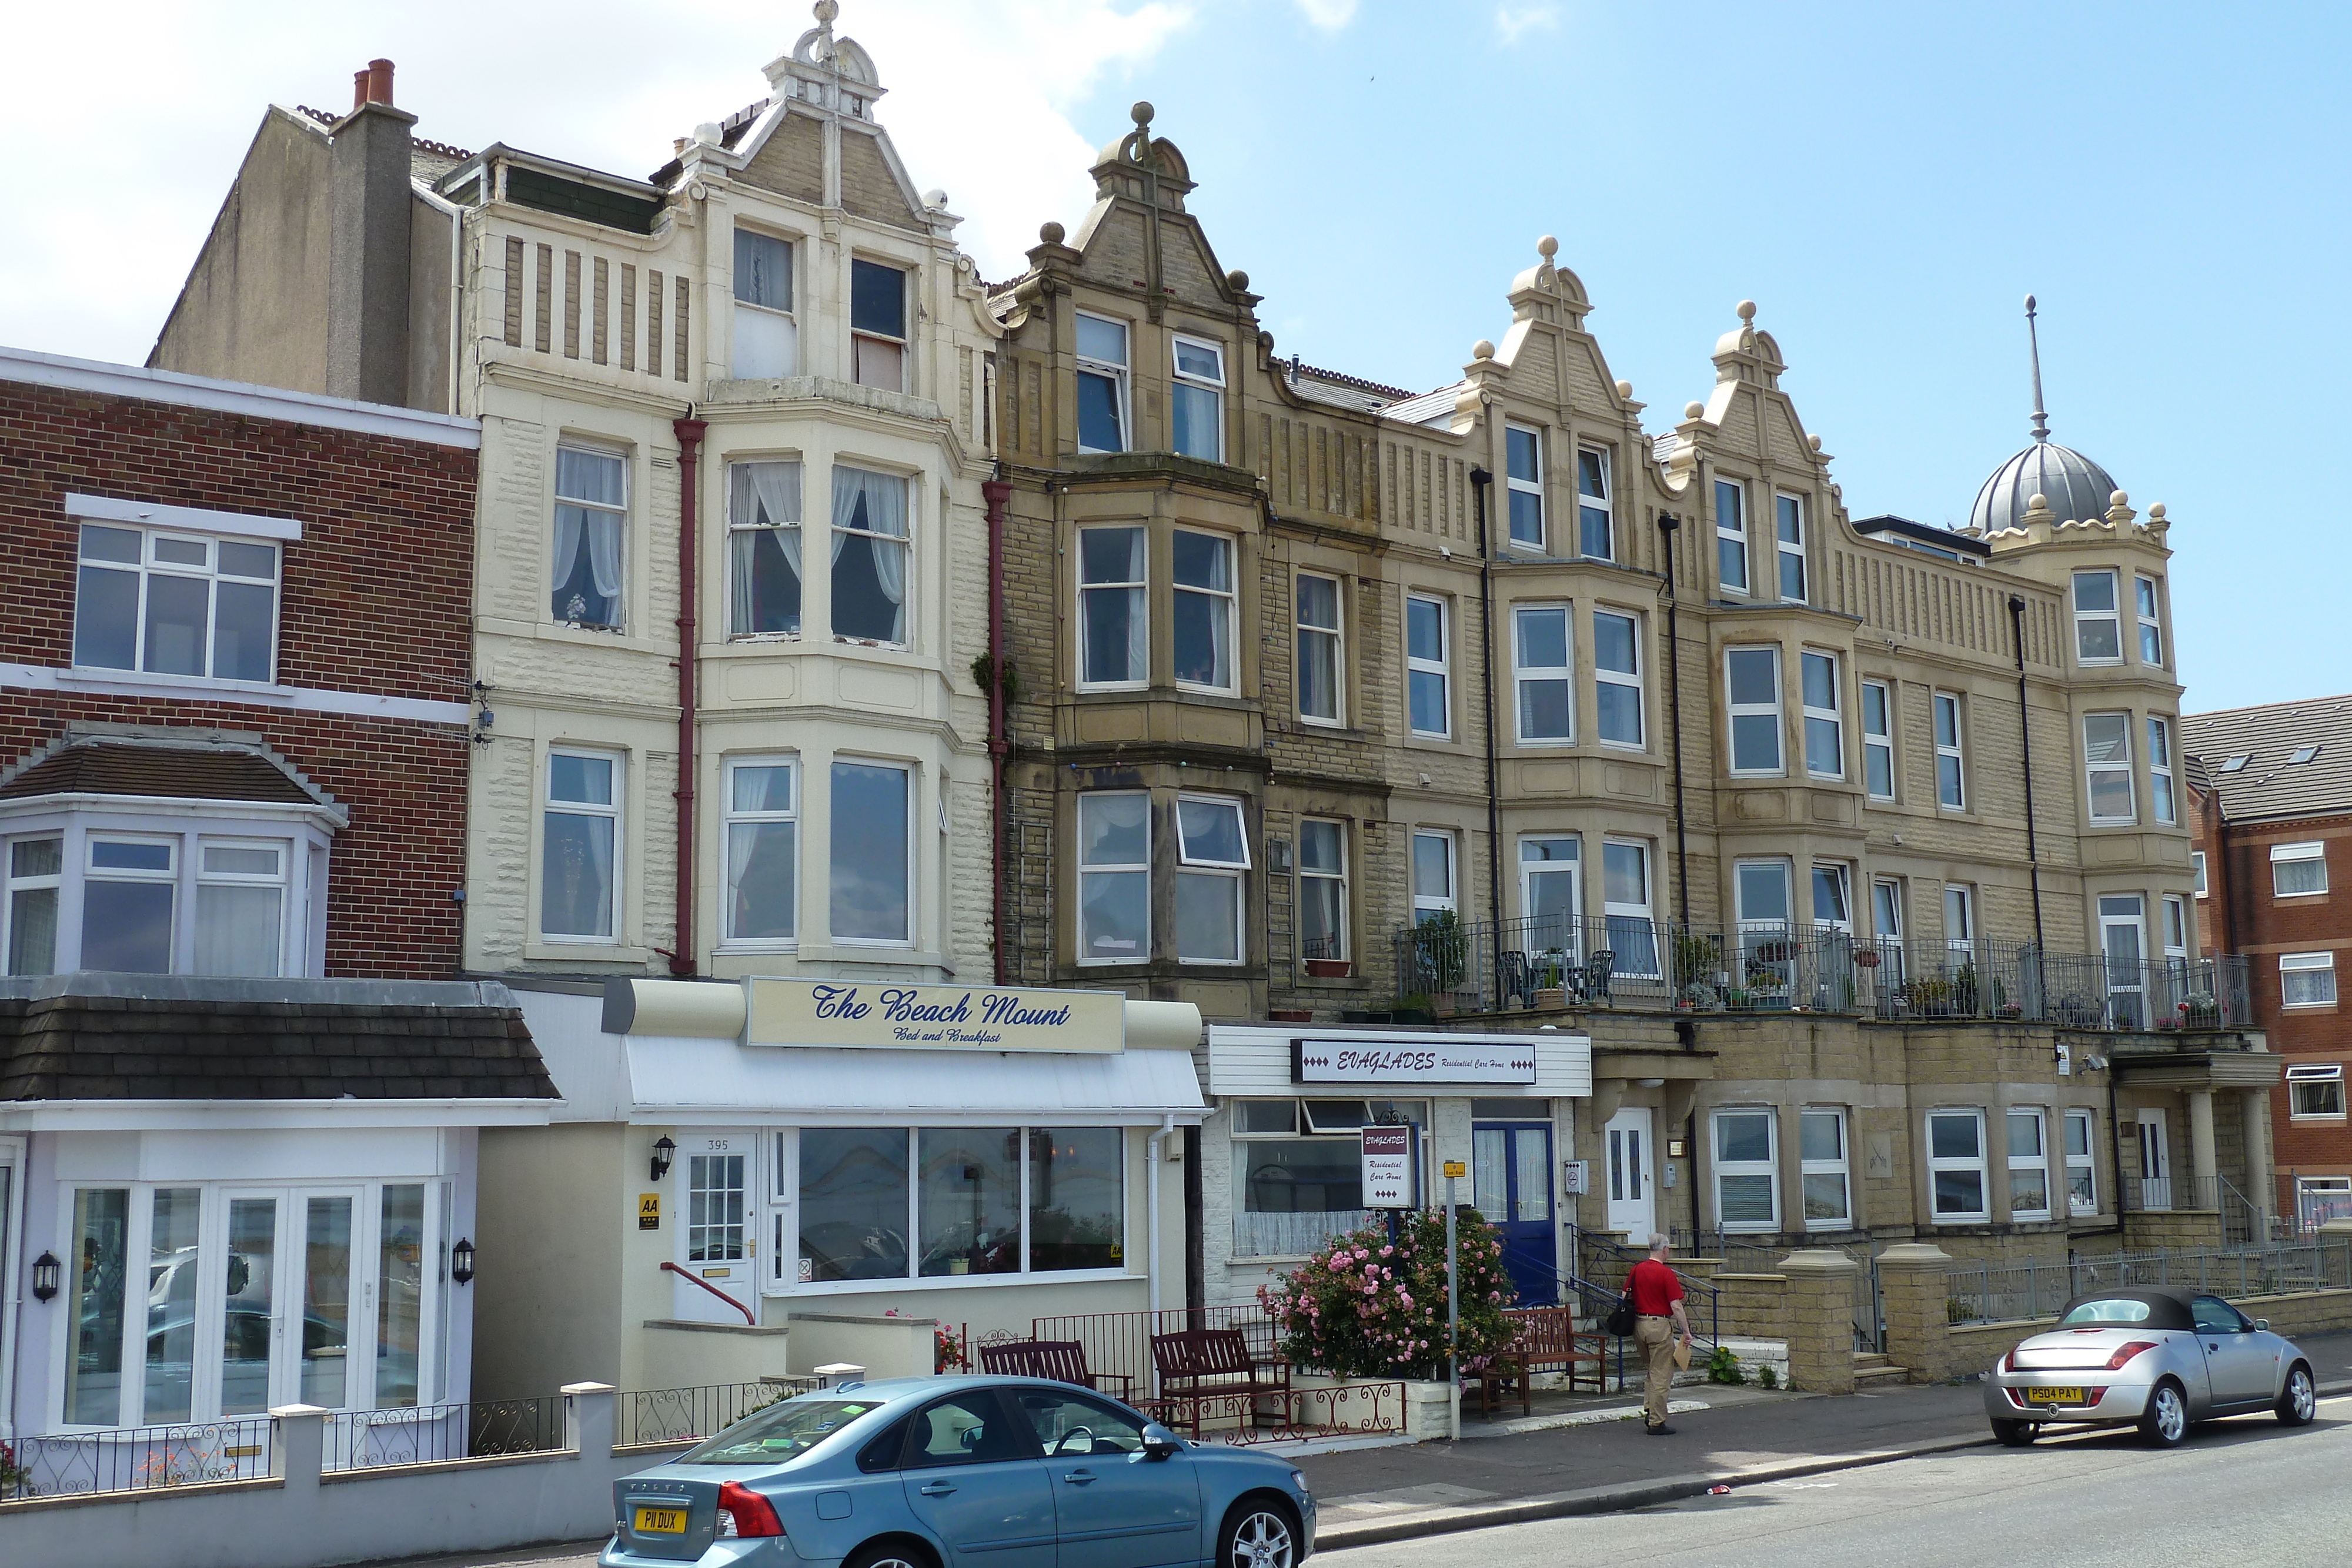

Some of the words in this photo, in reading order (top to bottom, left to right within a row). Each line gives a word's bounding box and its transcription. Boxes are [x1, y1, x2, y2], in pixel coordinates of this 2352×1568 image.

[812, 985, 873, 1019] The
[880, 989, 973, 1023] Beach
[981, 994, 1071, 1026] Mount
[893, 1027, 921, 1041] Bed
[921, 1029, 944, 1041] and
[946, 1028, 1001, 1047] Breakfast
[1337, 1051, 1436, 1075] EVAGLADES
[1441, 1058, 1473, 1068] Residential
[1474, 1059, 1488, 1069] Care
[1489, 1059, 1505, 1068] Home
[708, 1139, 729, 1150] 395
[1365, 1136, 1405, 1146] EVAGLADES
[1369, 1160, 1402, 1168] Residential
[1369, 1172, 1384, 1182] Care
[1385, 1172, 1402, 1181] Home
[642, 1199, 657, 1212] AA
[1112, 1246, 1121, 1255] AA
[2032, 1388, 2056, 1398] PS04
[2059, 1388, 2077, 1398] PAT
[657, 1512, 677, 1529] DUX
